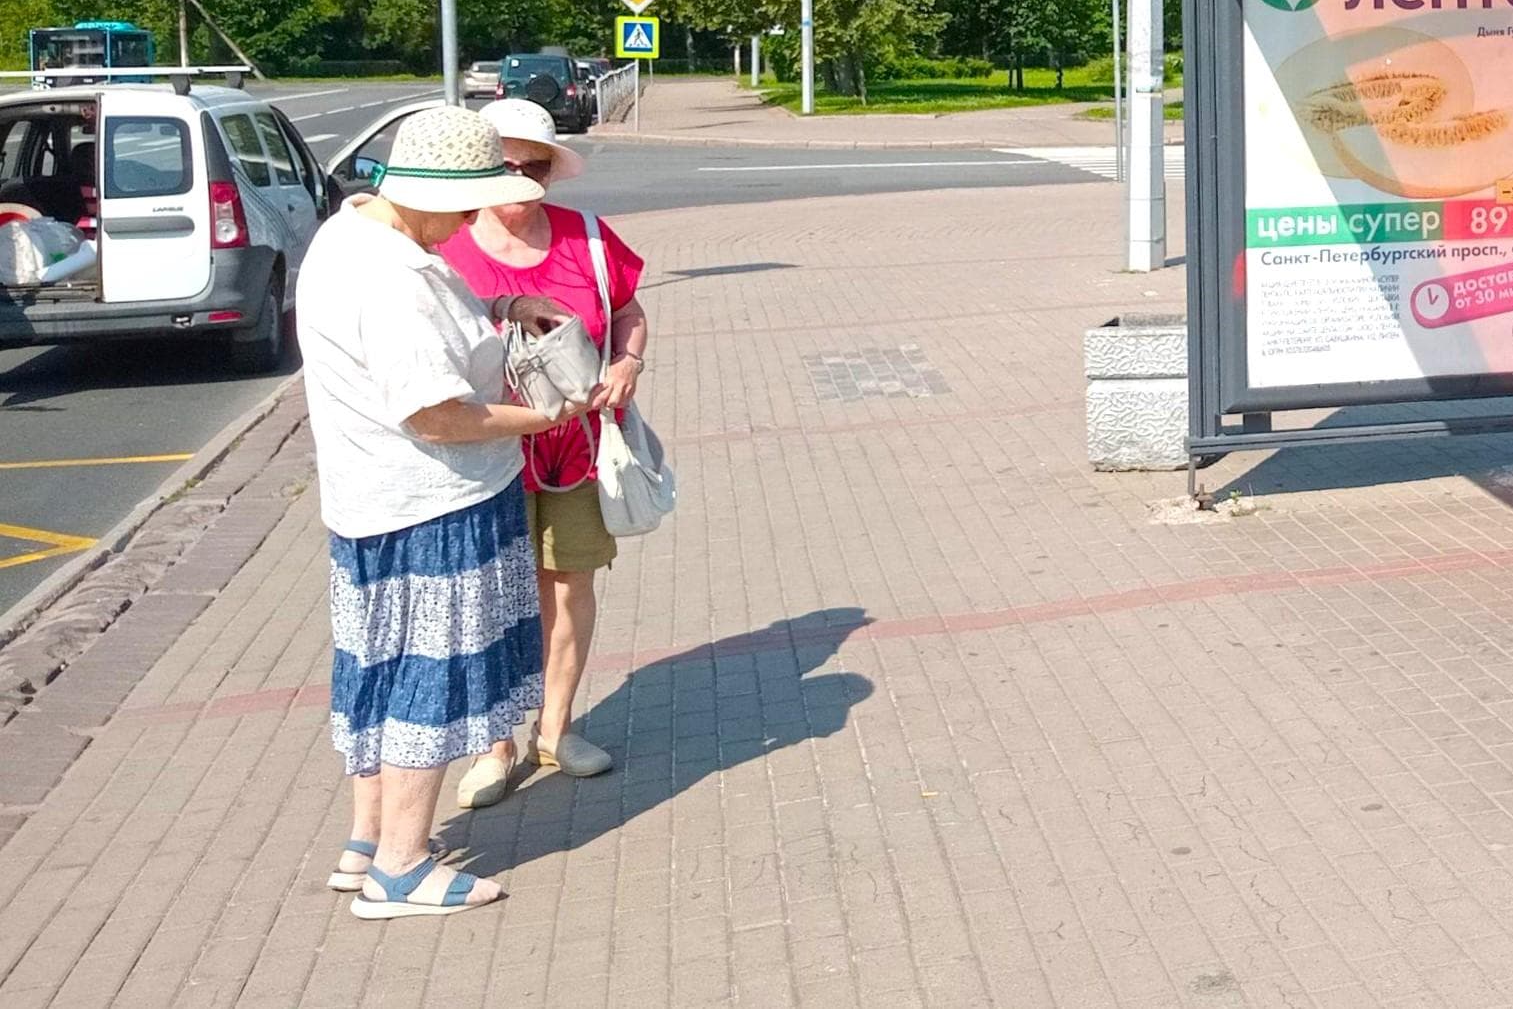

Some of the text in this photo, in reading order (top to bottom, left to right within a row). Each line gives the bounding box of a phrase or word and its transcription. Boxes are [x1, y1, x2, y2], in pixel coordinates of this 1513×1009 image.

[1257, 210, 1441, 242] цены супер
[1261, 243, 1447, 266] Санкт-Петербургский
[1451, 245, 1507, 262] просп.,
[1455, 296, 1472, 309] от
[1475, 288, 1496, 305] 30
